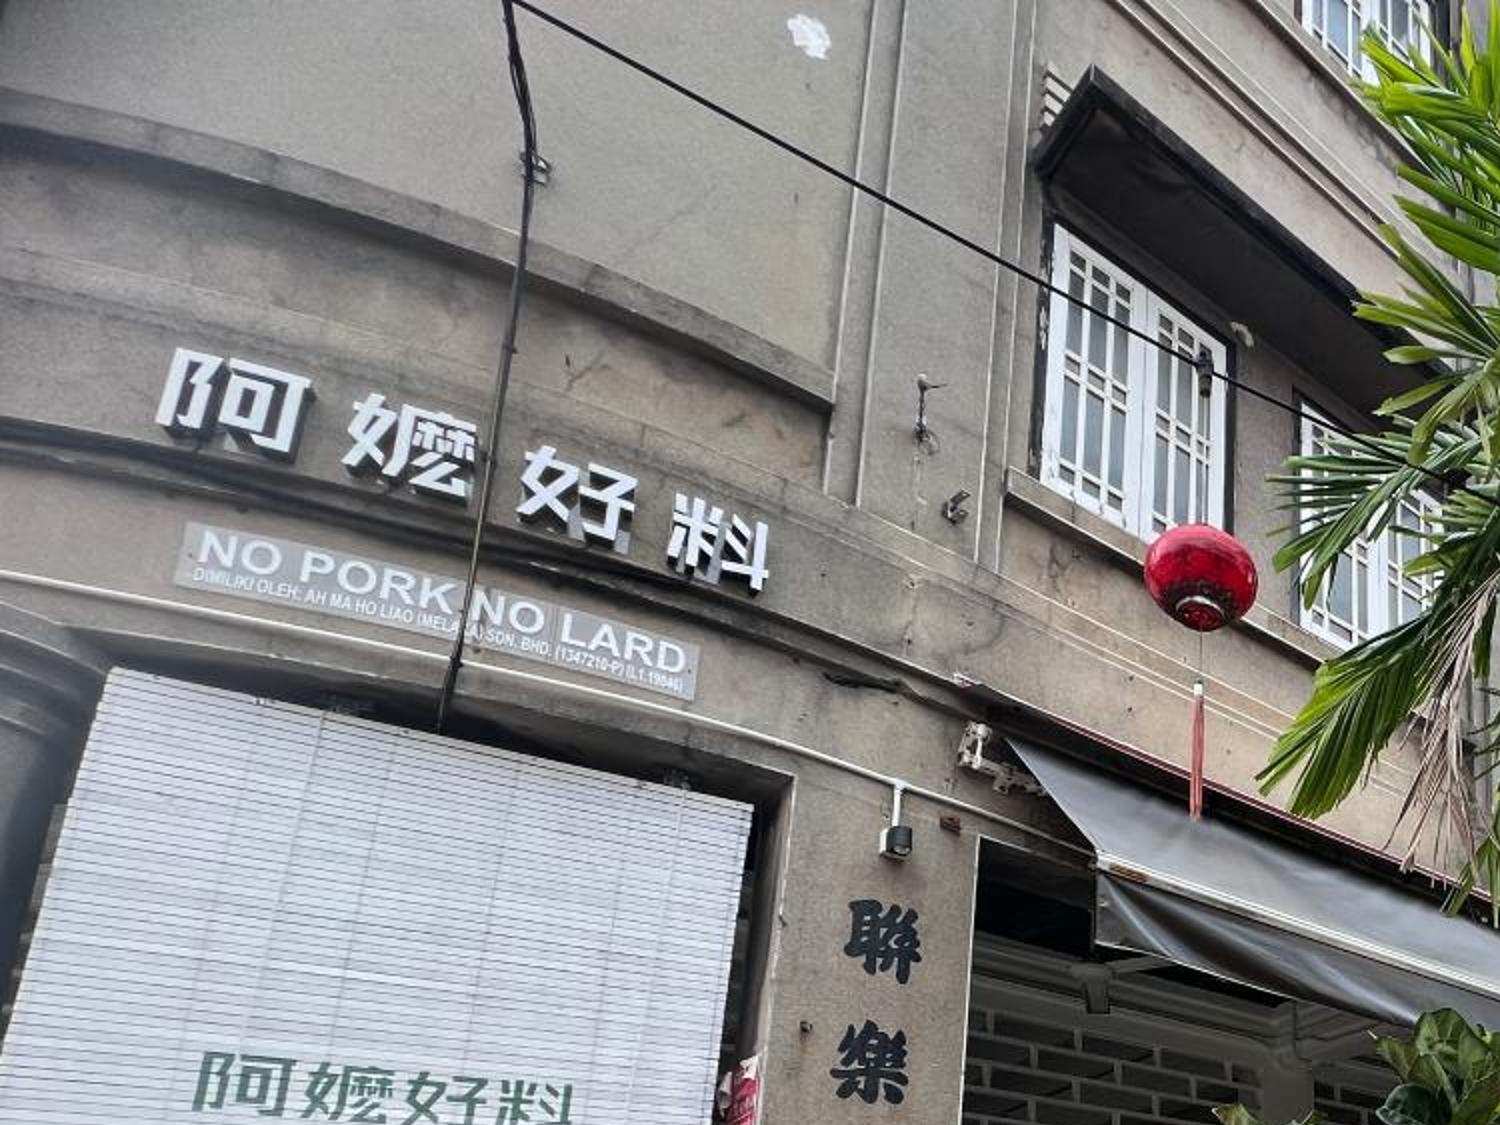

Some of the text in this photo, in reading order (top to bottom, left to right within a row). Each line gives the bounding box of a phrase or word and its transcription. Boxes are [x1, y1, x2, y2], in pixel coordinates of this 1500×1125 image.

[197, 530, 687, 673] NO PORK NO LARD
[304, 589, 327, 605] AH
[330, 593, 351, 608] MA
[355, 600, 377, 615] HO
[380, 604, 413, 623] LIAO
